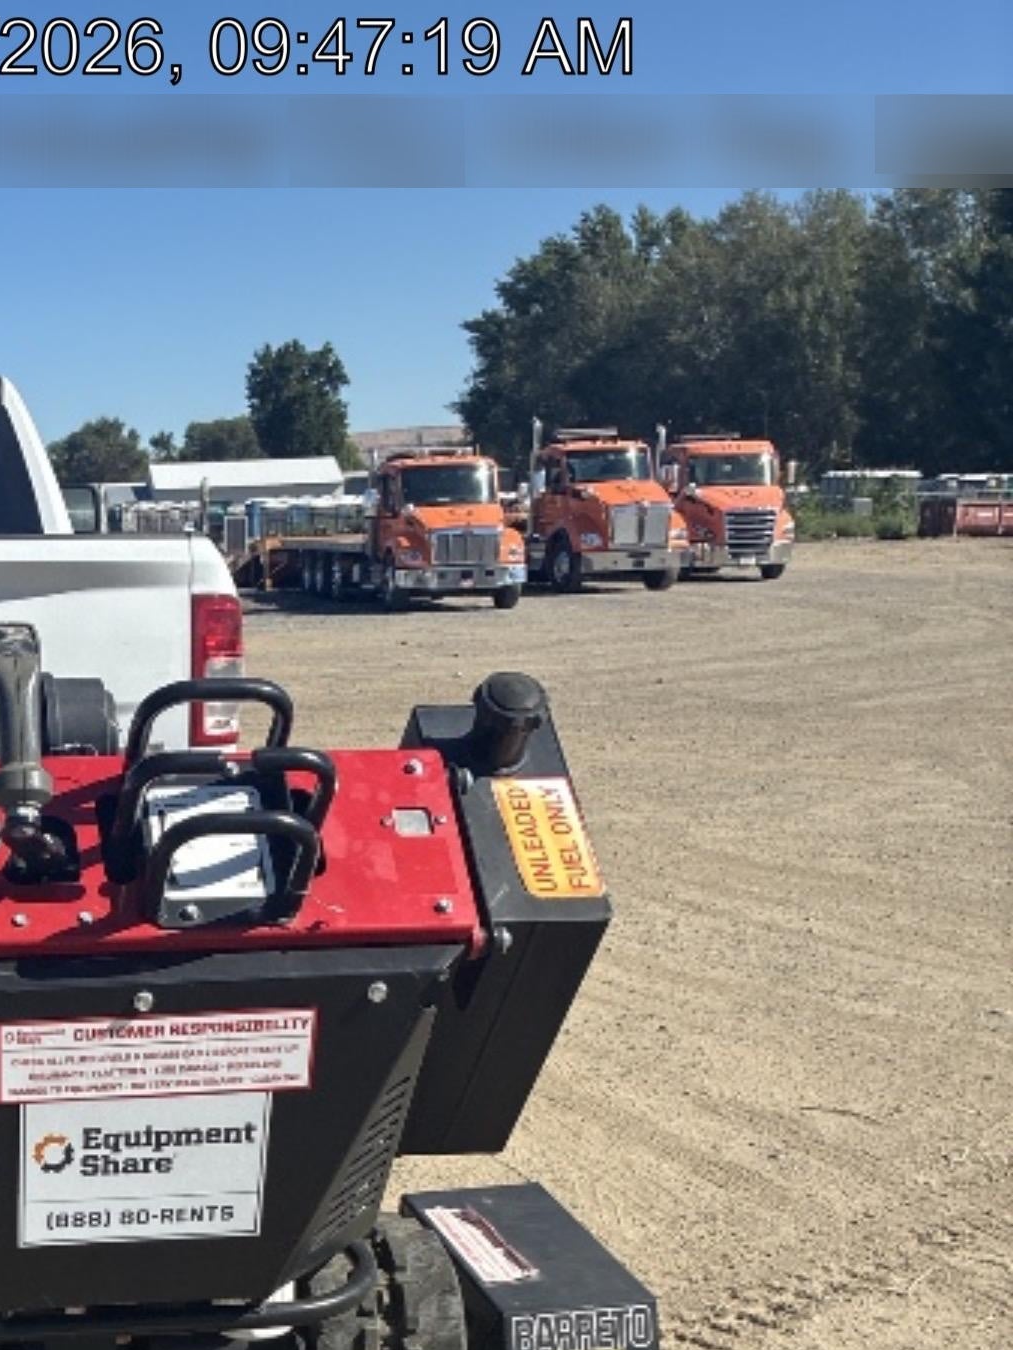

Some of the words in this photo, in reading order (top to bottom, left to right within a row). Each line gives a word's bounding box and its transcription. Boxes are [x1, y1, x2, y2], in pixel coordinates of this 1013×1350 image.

[540, 785, 573, 836] ONLY
[506, 785, 557, 891] UNLEADED
[560, 840, 591, 890] FUEL
[73, 1025, 165, 1042] CUSTOMER
[170, 1017, 309, 1036] RESPONSIBILITY
[81, 1121, 257, 1153] Equipment
[80, 1152, 175, 1177] Share
[46, 1211, 112, 1230] (888)
[119, 1205, 234, 1227] 80-RENTS
